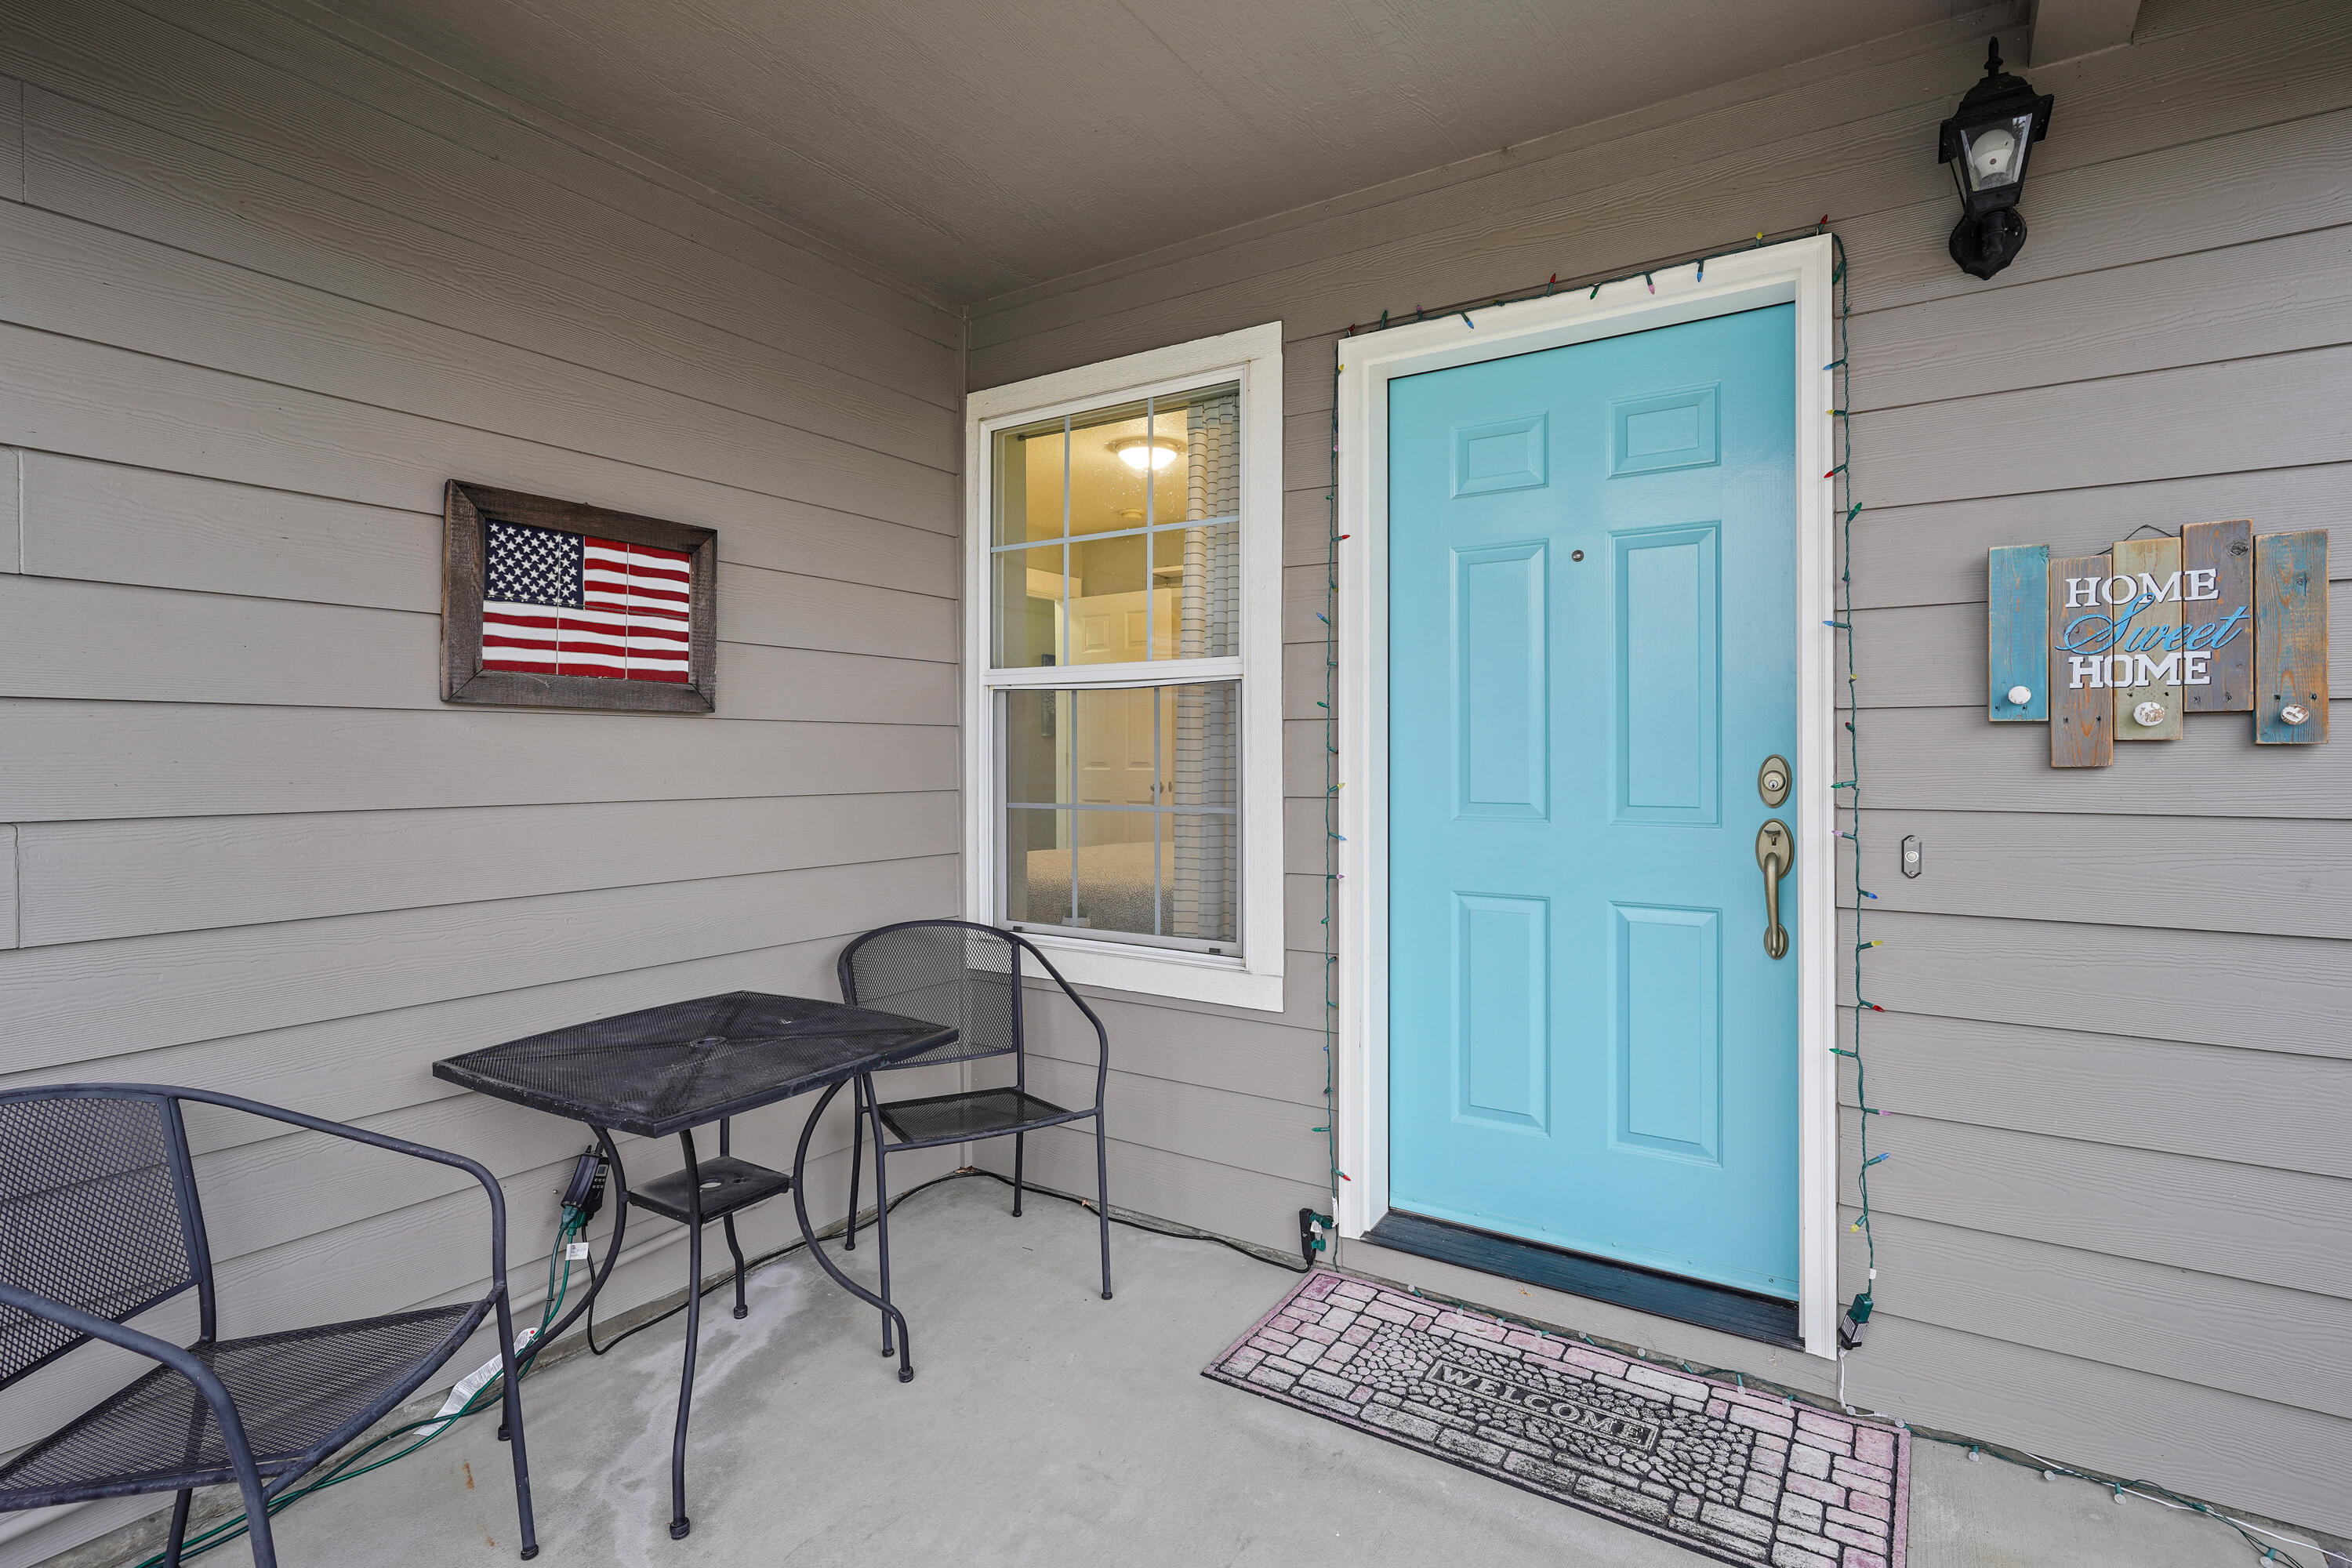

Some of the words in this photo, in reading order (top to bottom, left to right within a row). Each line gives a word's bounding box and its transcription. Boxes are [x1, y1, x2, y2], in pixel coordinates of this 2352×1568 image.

[2064, 568, 2220, 608] HOME
[2054, 593, 2250, 654] Sweet
[2068, 651, 2212, 689] HOME
[1441, 1365, 1643, 1443] WELCOME
